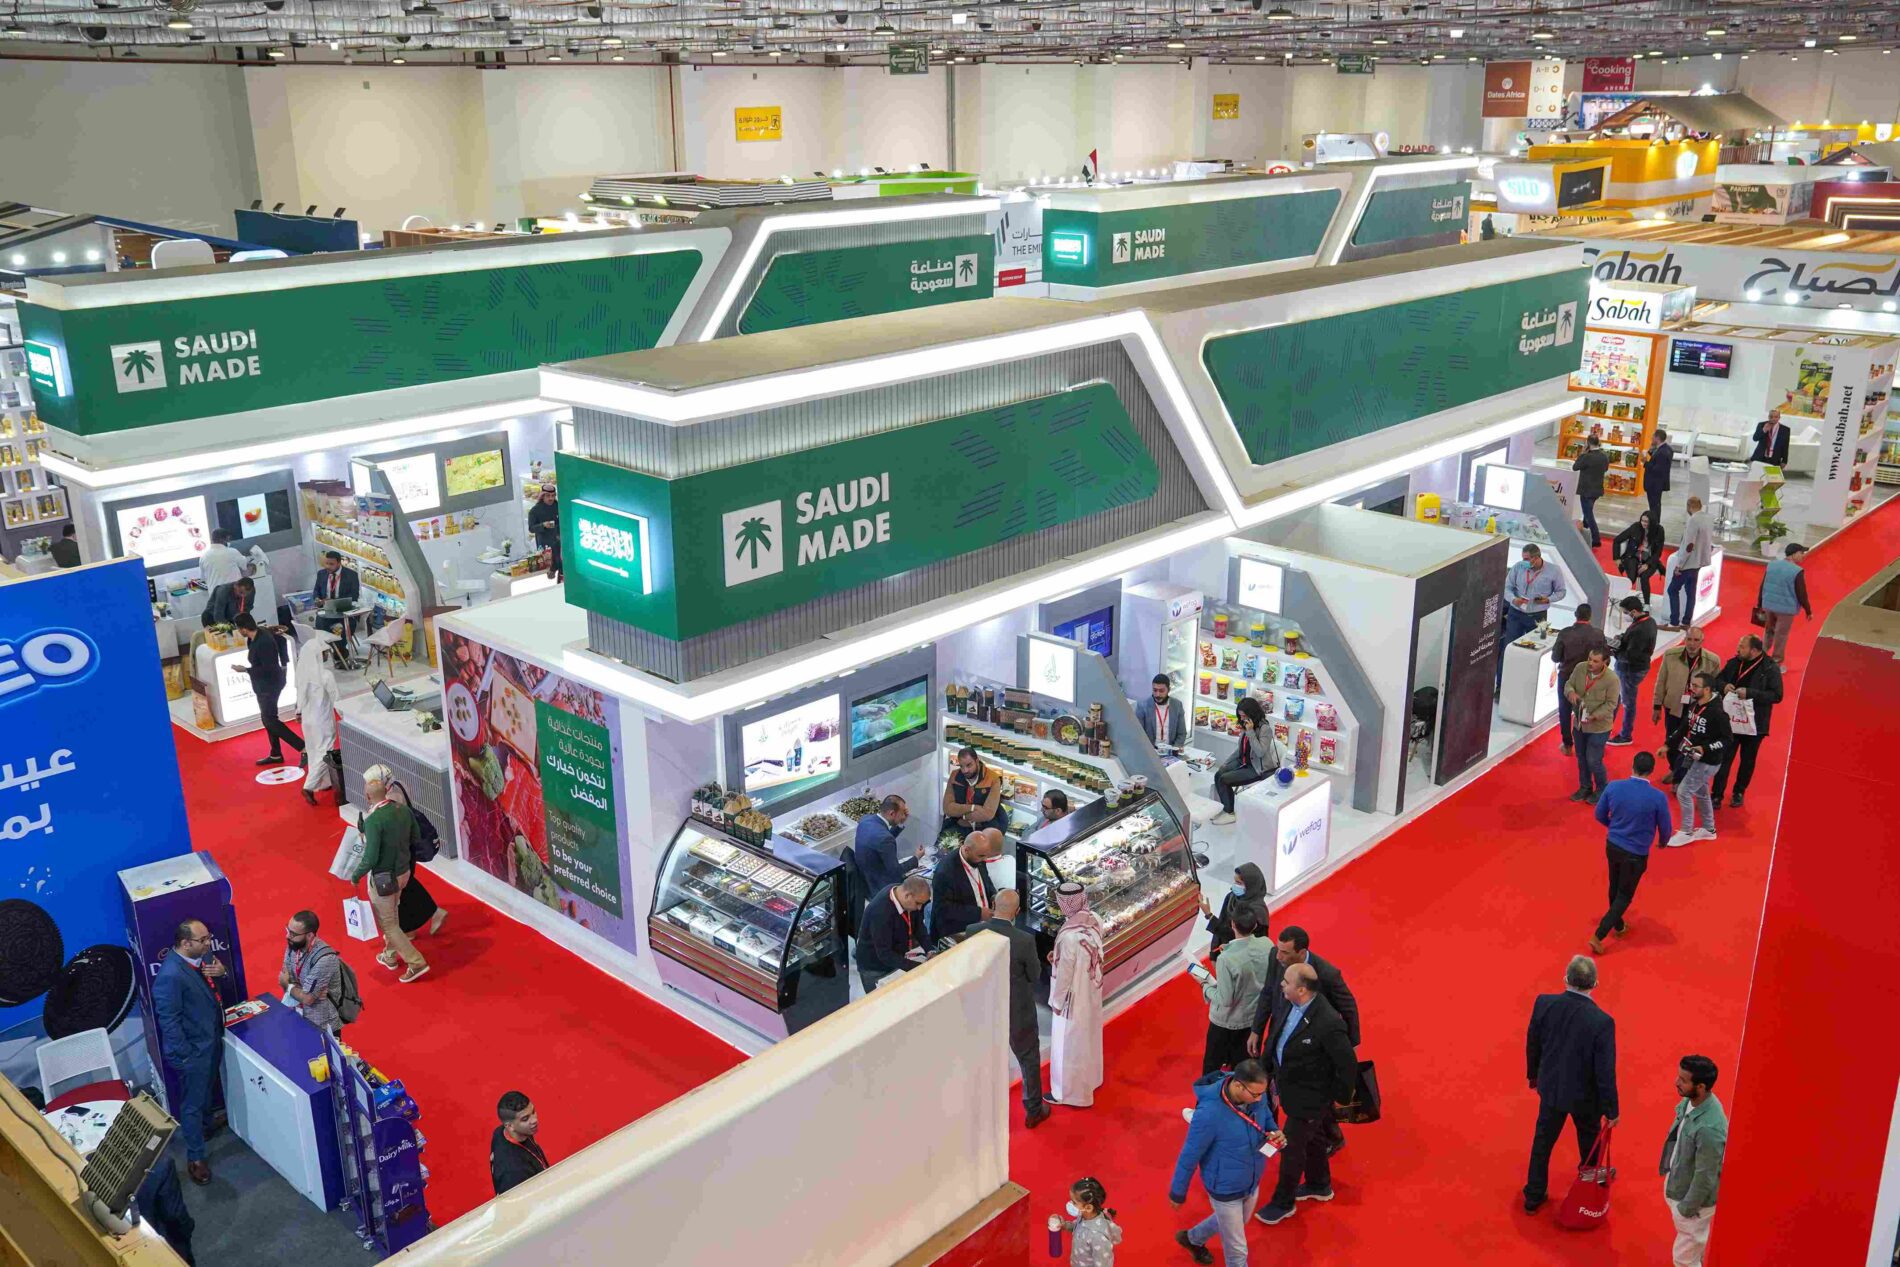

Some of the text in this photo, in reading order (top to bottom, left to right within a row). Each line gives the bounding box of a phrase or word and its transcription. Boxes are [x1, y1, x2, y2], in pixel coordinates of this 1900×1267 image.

[1591, 65, 1632, 77] Cooking
[1487, 90, 1526, 99] Dates Africa
[1730, 184, 1759, 193] PAKISTAN
[1134, 228, 1166, 244] SAUDI
[1012, 245, 1026, 256] THE
[1134, 244, 1165, 261] MADE
[911, 259, 954, 275] صناعة
[910, 276, 954, 294] سعودية
[1521, 307, 1557, 331] صناعة
[1591, 297, 1651, 324] Sabah
[174, 328, 257, 359] SAUDI
[1519, 332, 1555, 356] سعودية
[179, 354, 261, 386] MADE
[1828, 385, 1854, 481] www.elsabah.net
[795, 471, 890, 525] SAUDI
[797, 511, 891, 567] MADE
[558, 738, 578, 758] عالية
[572, 729, 603, 751] منتجات
[546, 755, 606, 790] لتكون خيارك
[570, 784, 608, 811] المفضل
[548, 810, 585, 840] Top quality
[550, 831, 579, 851] products
[551, 844, 593, 874] To be your
[553, 864, 617, 904] preferred choice
[378, 1139, 413, 1163] Dairy Milk
